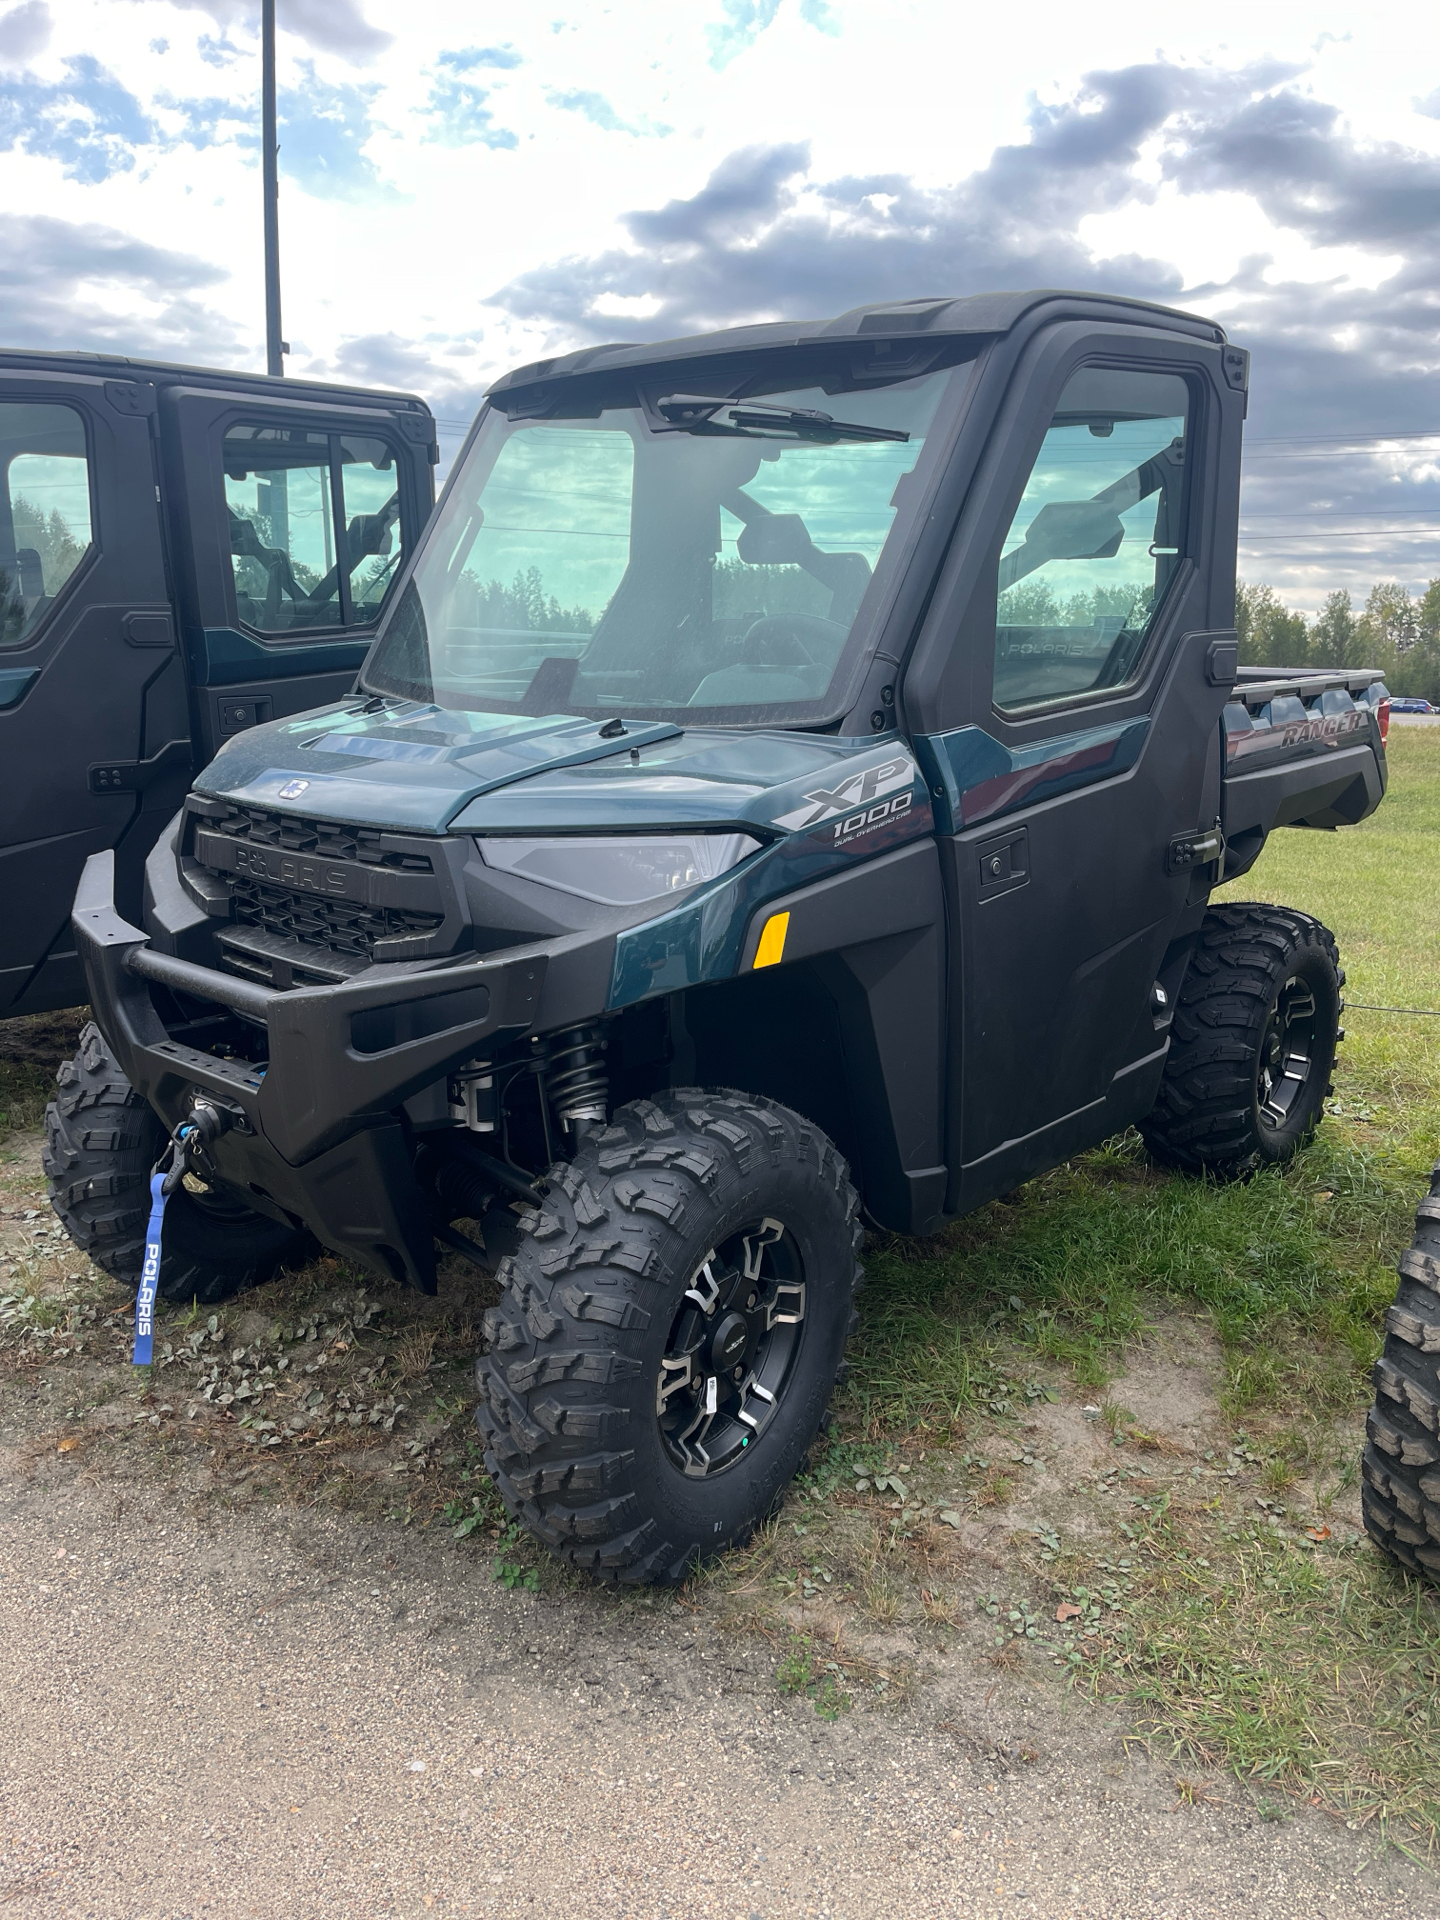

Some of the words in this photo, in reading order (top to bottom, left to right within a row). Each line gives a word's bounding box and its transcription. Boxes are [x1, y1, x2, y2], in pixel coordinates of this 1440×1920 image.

[1008, 643, 1084, 656] POLARIS
[1280, 710, 1363, 749] RANGER
[797, 757, 914, 830] XP
[833, 792, 912, 838] 1000
[833, 836, 855, 848] DUAL
[856, 817, 895, 837] OVERHEAD
[896, 809, 912, 821] CAM
[235, 847, 347, 894] POLARIS
[138, 1243, 159, 1336] POLARIS
